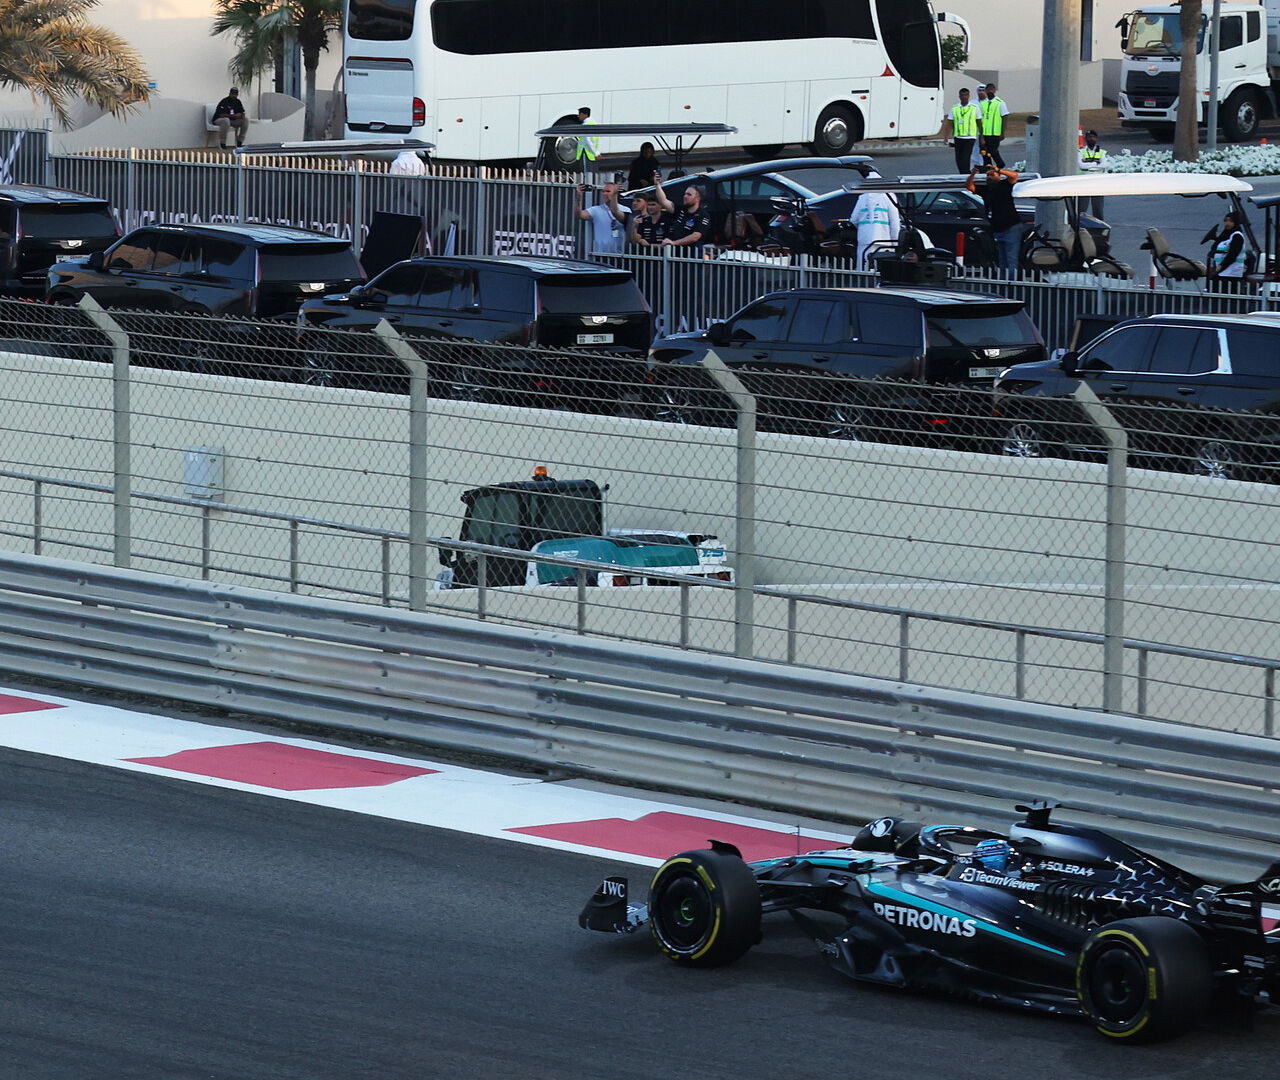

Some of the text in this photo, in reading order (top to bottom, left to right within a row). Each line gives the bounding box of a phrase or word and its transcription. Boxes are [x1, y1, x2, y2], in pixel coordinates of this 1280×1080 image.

[1045, 861, 1089, 877] SOLERA
[602, 879, 626, 898] IWC
[975, 870, 1041, 892] TeamViewer
[874, 903, 977, 938] PETRONAS
